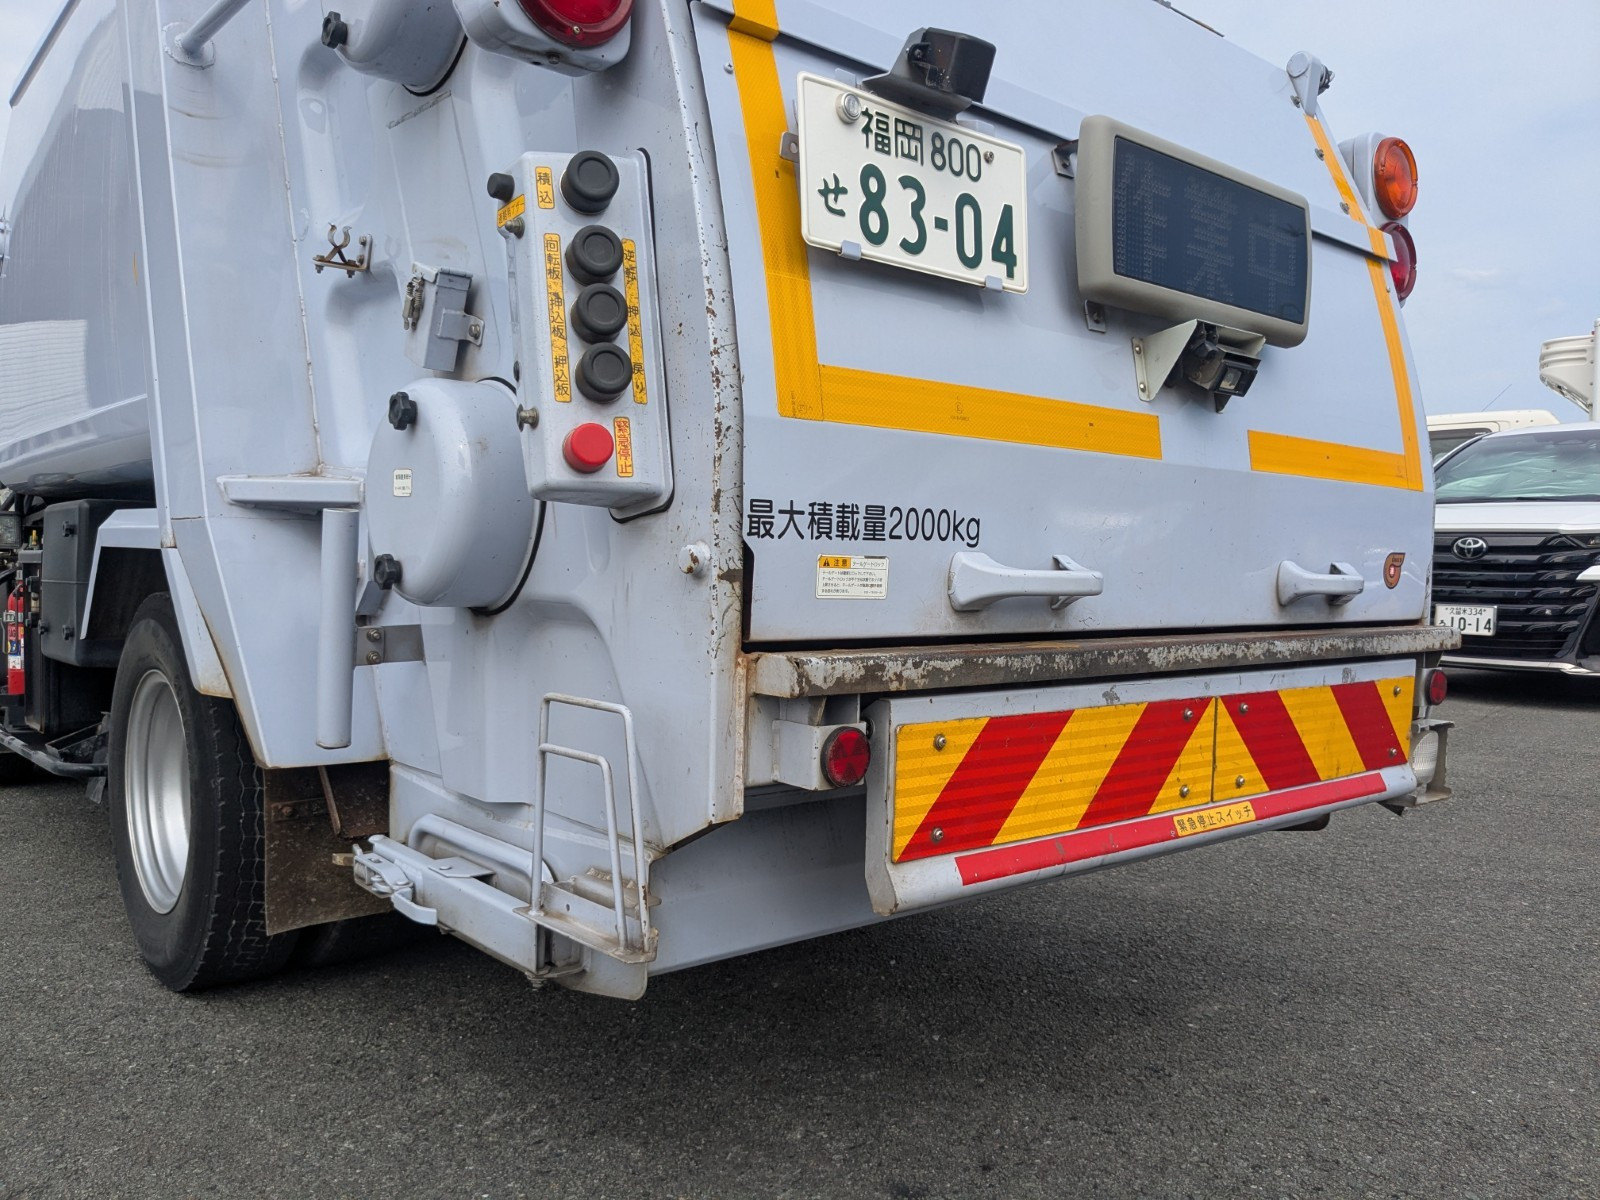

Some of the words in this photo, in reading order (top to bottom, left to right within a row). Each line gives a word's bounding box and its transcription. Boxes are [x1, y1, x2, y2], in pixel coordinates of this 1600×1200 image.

[861, 107, 925, 167] 福岡
[930, 131, 982, 183] 800
[537, 171, 553, 204] 積込
[817, 172, 849, 217] せ
[859, 163, 1018, 279] 83-04
[546, 240, 560, 280] 回転板
[550, 297, 567, 340] 押込板
[554, 355, 570, 396] 押込板
[615, 420, 632, 474] 緊急停止
[746, 498, 981, 548] 最大積載量2000kg
[833, 558, 848, 567] 注意
[1450, 616, 1492, 632] 10-14
[1468, 607, 1483, 616] 334
[1176, 804, 1252, 833] 緊急停止スイッチ
